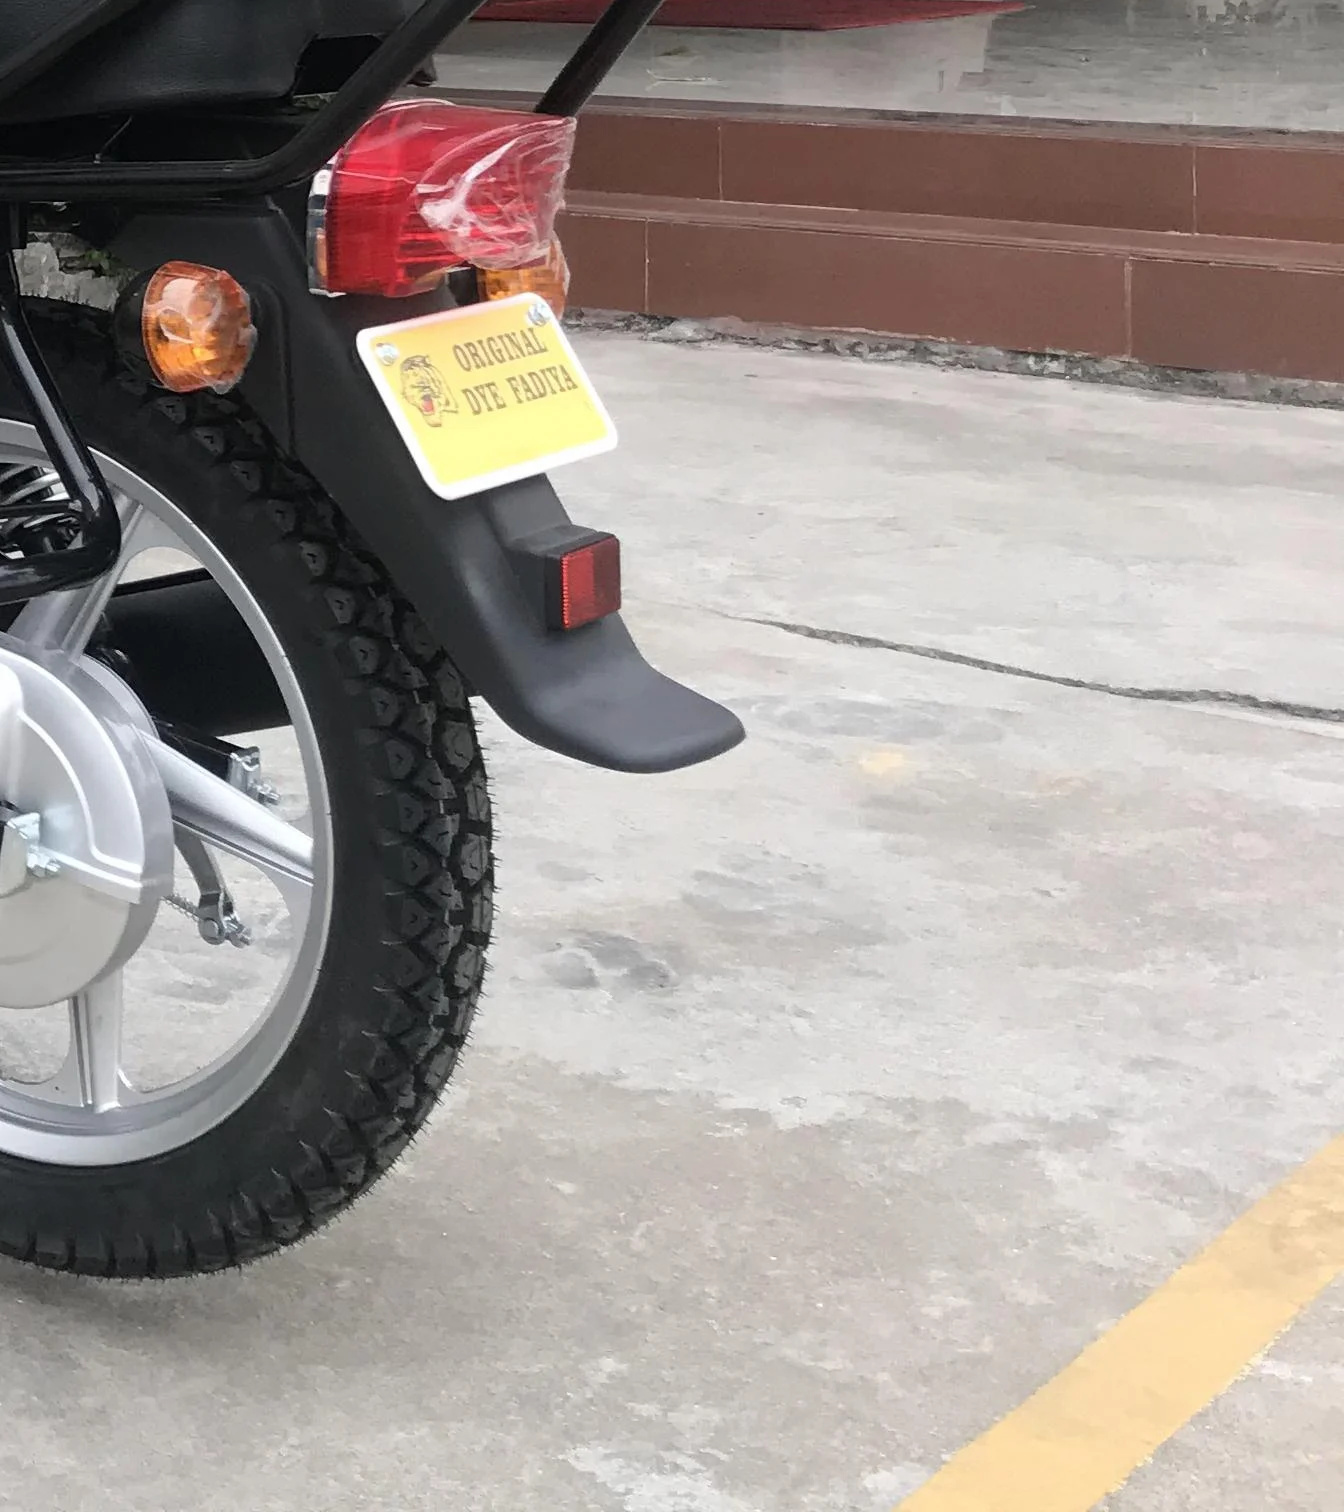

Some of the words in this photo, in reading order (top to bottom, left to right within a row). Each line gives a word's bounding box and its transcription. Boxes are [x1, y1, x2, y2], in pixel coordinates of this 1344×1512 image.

[451, 327, 548, 373] ORIGINAL
[461, 381, 508, 416] DYE
[505, 364, 578, 405] FADIYA
